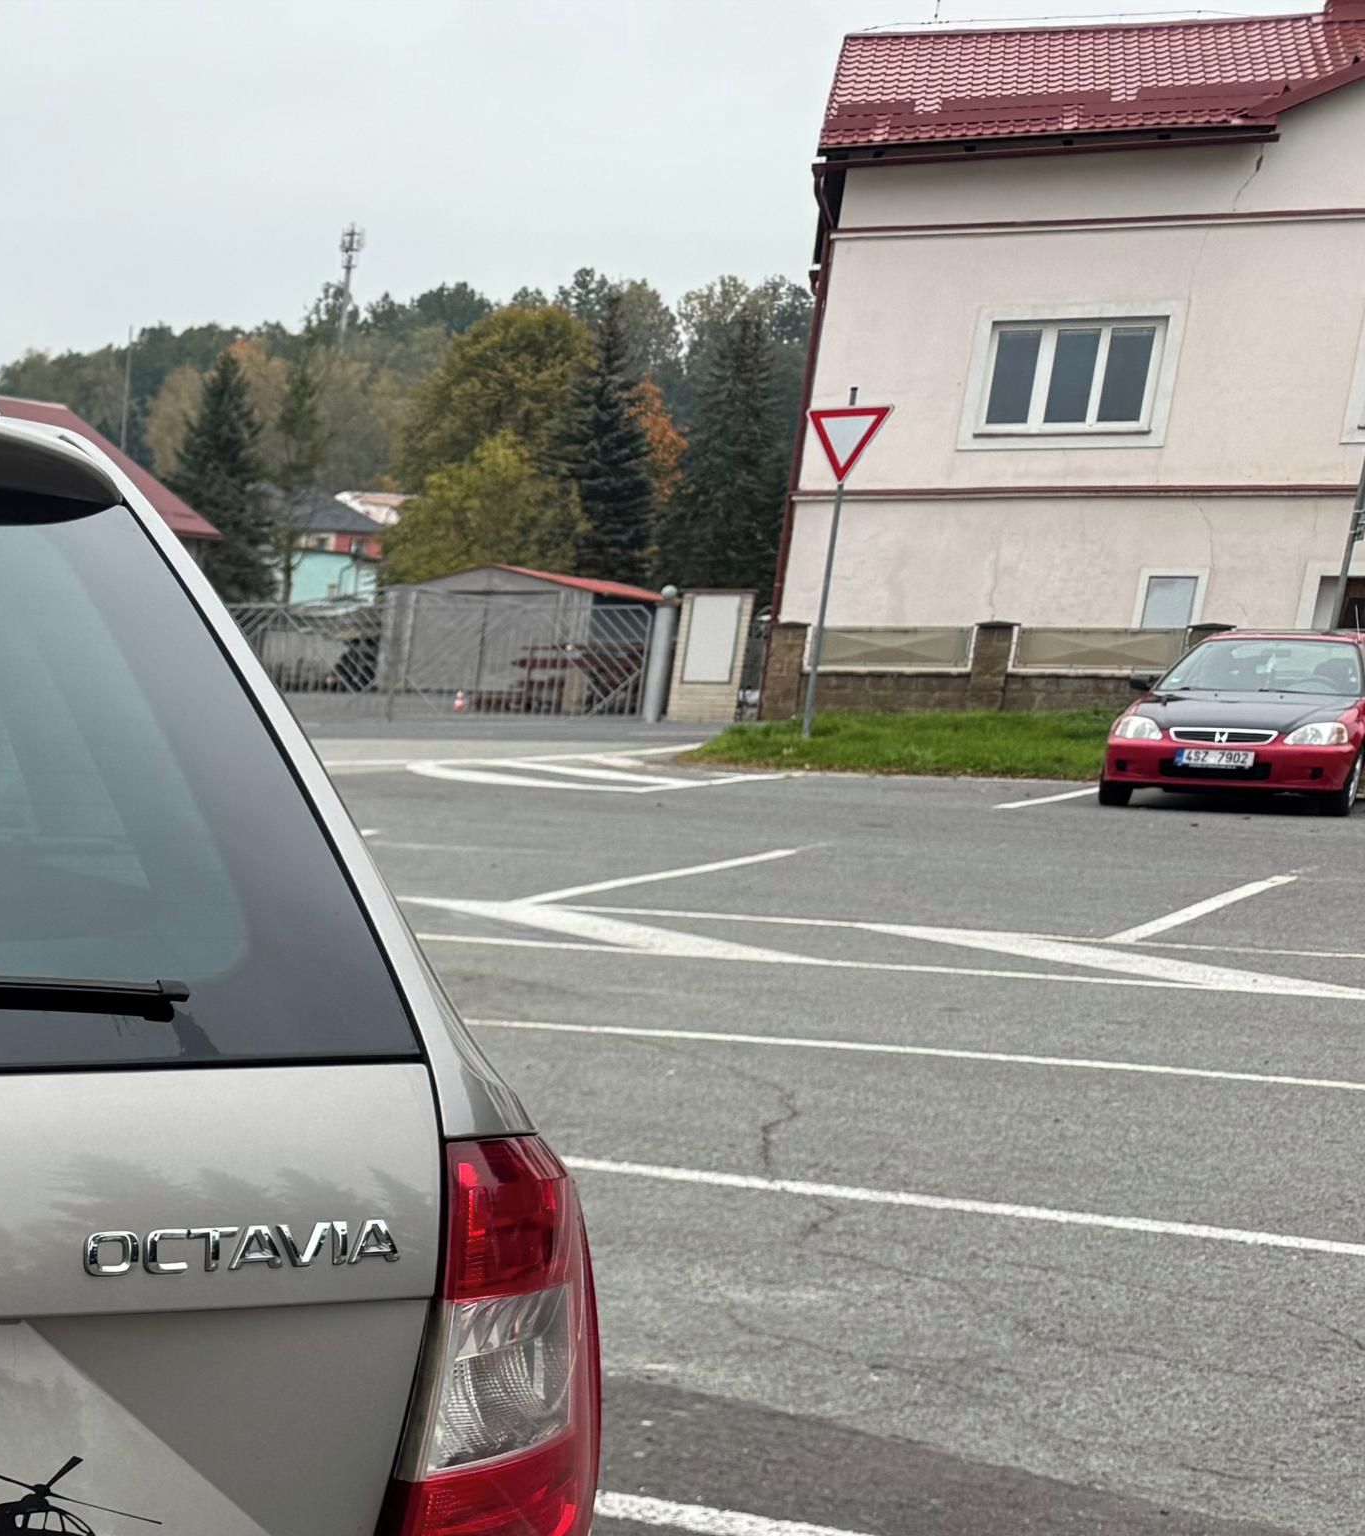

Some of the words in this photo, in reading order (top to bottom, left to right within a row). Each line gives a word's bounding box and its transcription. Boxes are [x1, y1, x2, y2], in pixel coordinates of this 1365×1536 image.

[1186, 751, 1209, 763] 4SZ
[1217, 751, 1249, 764] 7902
[83, 1219, 400, 1276] OCTAVIA
